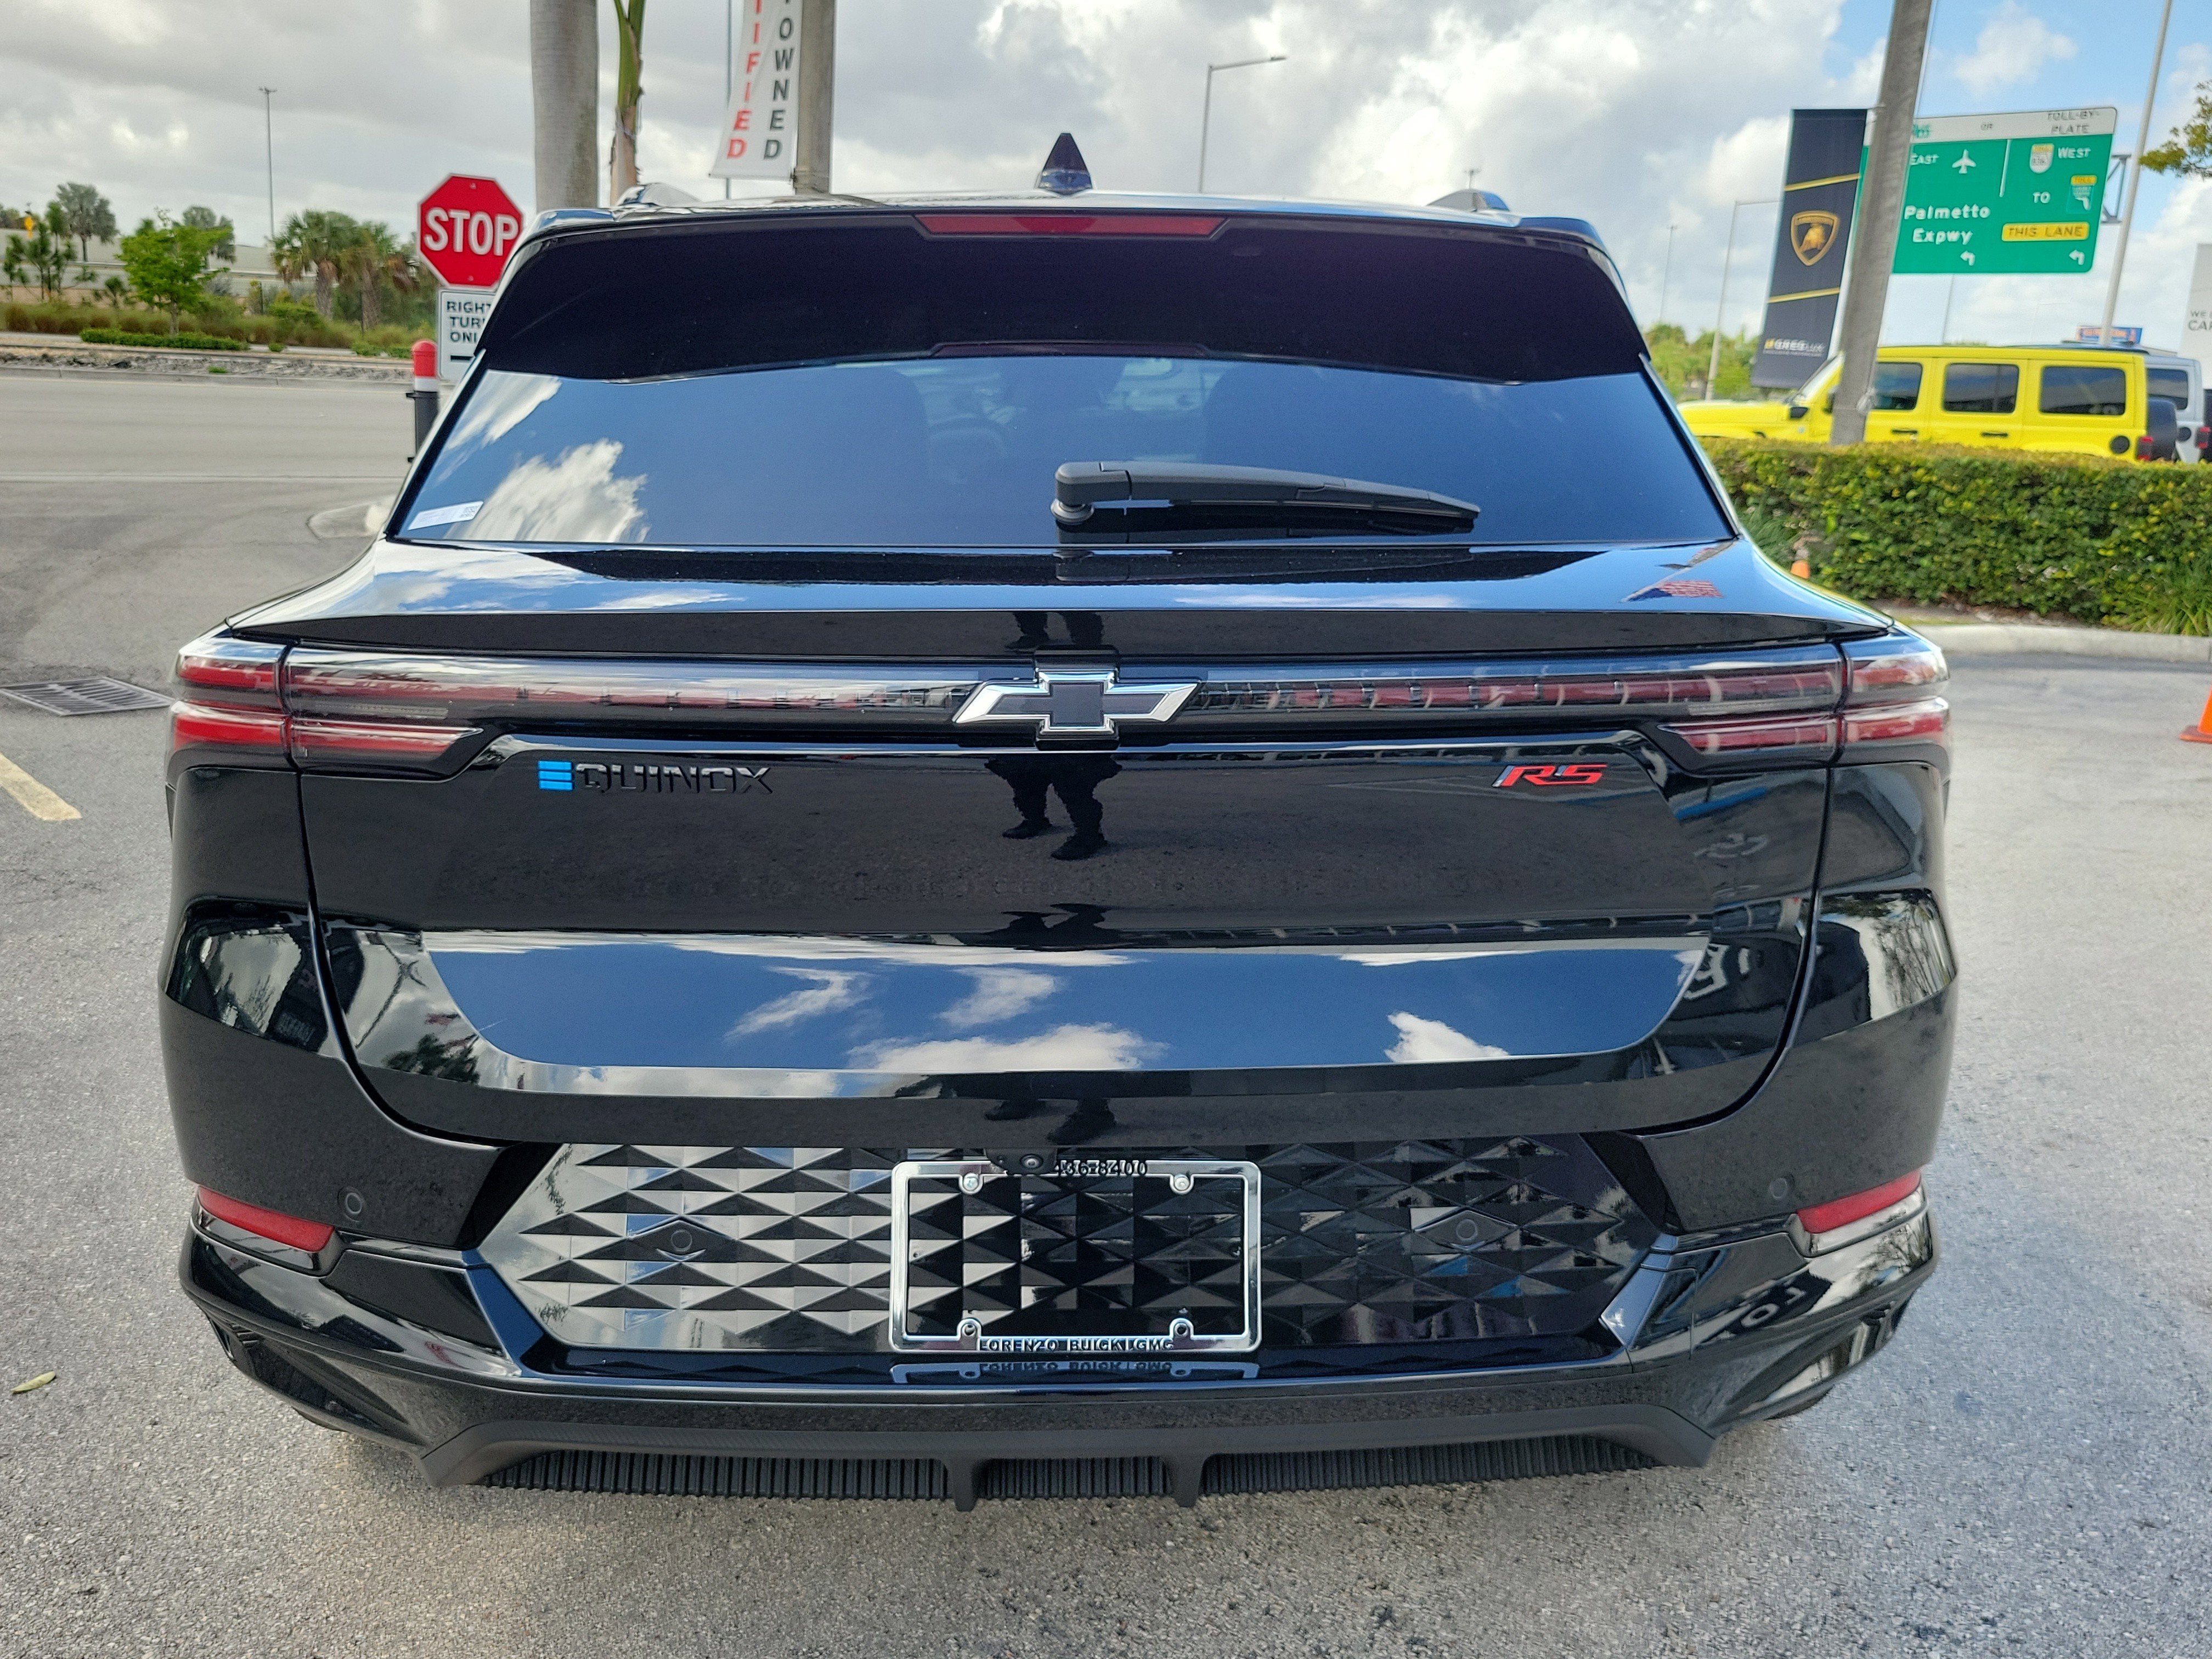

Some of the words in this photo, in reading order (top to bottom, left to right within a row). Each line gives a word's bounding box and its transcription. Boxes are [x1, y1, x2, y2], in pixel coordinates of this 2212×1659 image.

[2051, 125, 2090, 134] PLATE
[1909, 153, 1939, 165] EAST
[2058, 146, 2092, 159] WEST
[2032, 191, 2051, 204] TO
[1904, 204, 1991, 220] Palmetto
[424, 206, 519, 256] STOP
[1912, 227, 1973, 245] Expwy
[2008, 227, 2038, 238] THIS
[2045, 225, 2084, 238] LANE
[537, 760, 774, 794] EQUINOX
[1492, 763, 1607, 787] RS
[979, 1338, 1059, 1352] LORENZO
[1067, 1338, 1124, 1352] BUICK
